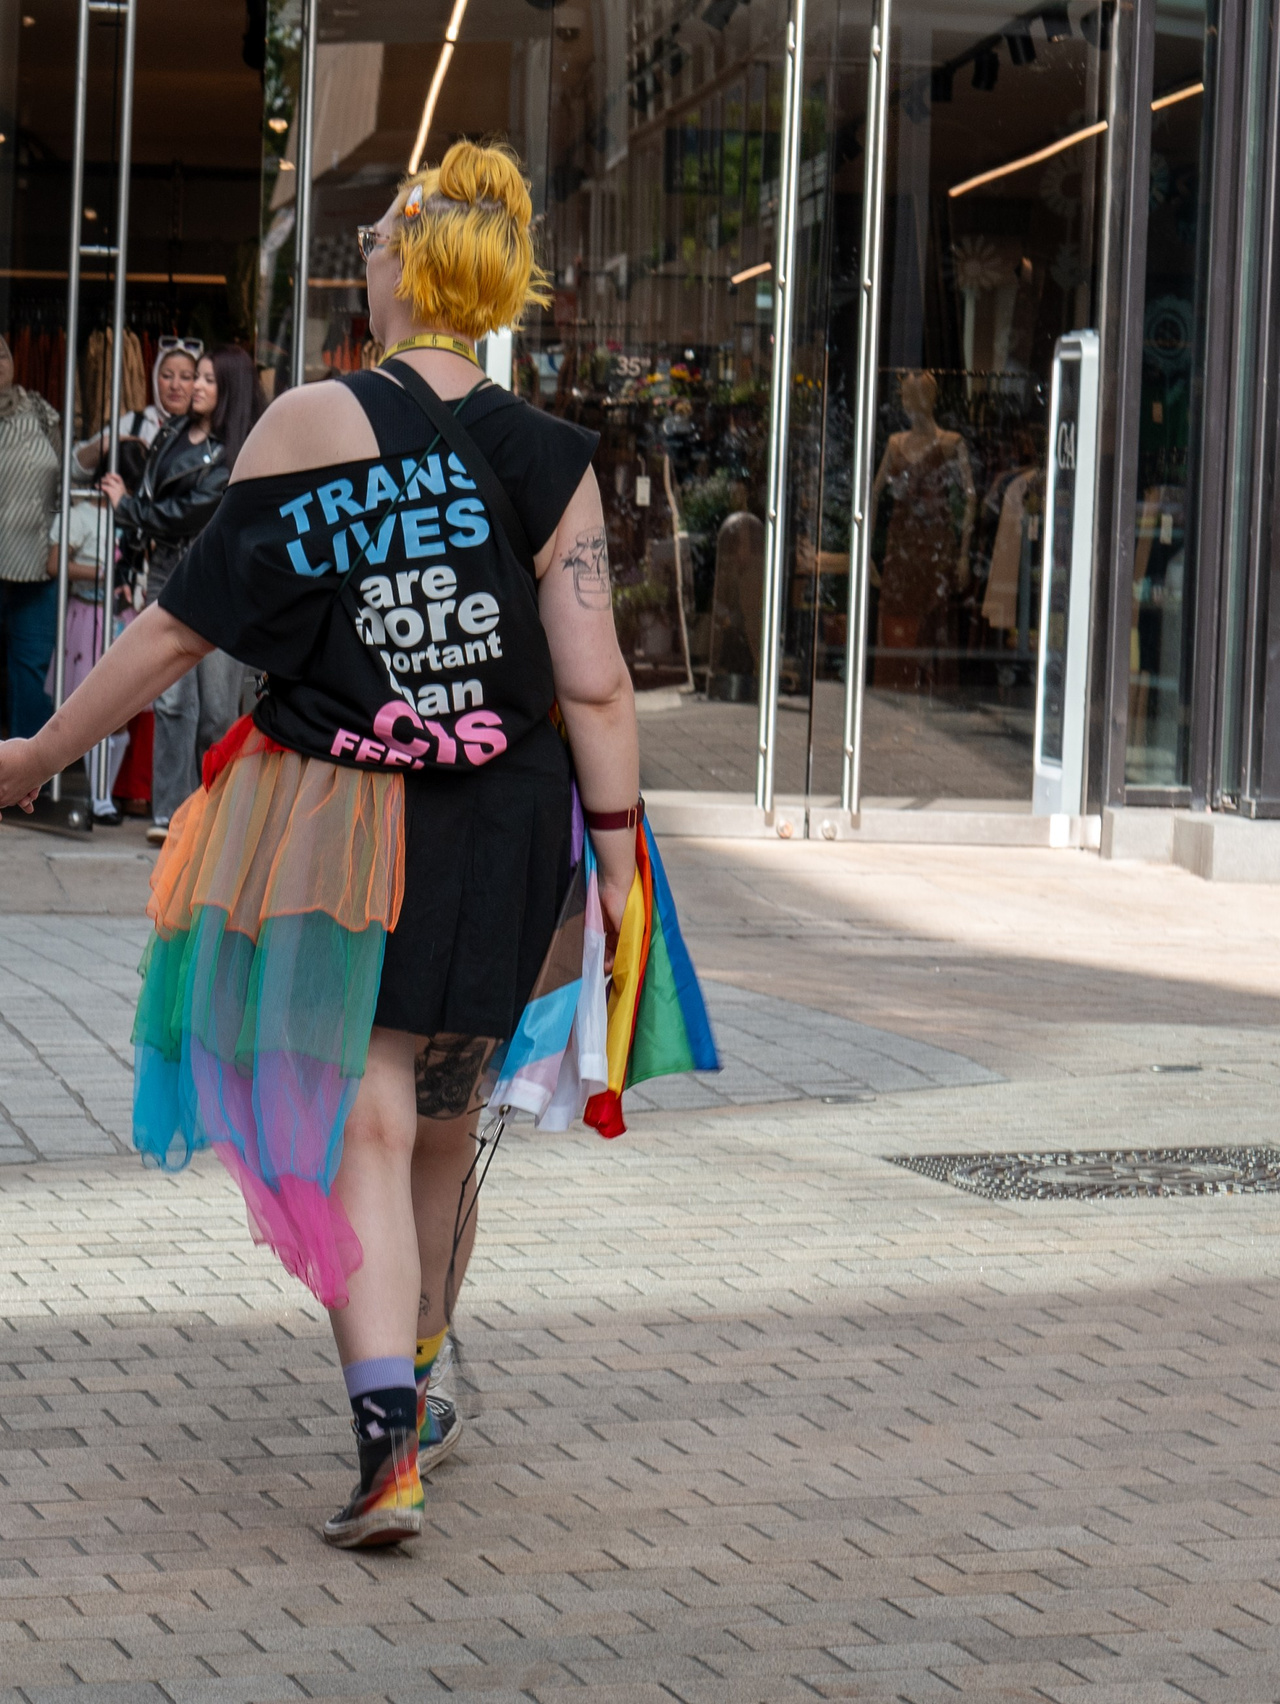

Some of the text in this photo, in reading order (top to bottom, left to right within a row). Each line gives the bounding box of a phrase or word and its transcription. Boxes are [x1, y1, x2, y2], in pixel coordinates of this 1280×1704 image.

[279, 451, 477, 535] TRANS
[286, 497, 490, 578] LIVES
[360, 565, 457, 609] are
[373, 700, 508, 766] CIS
